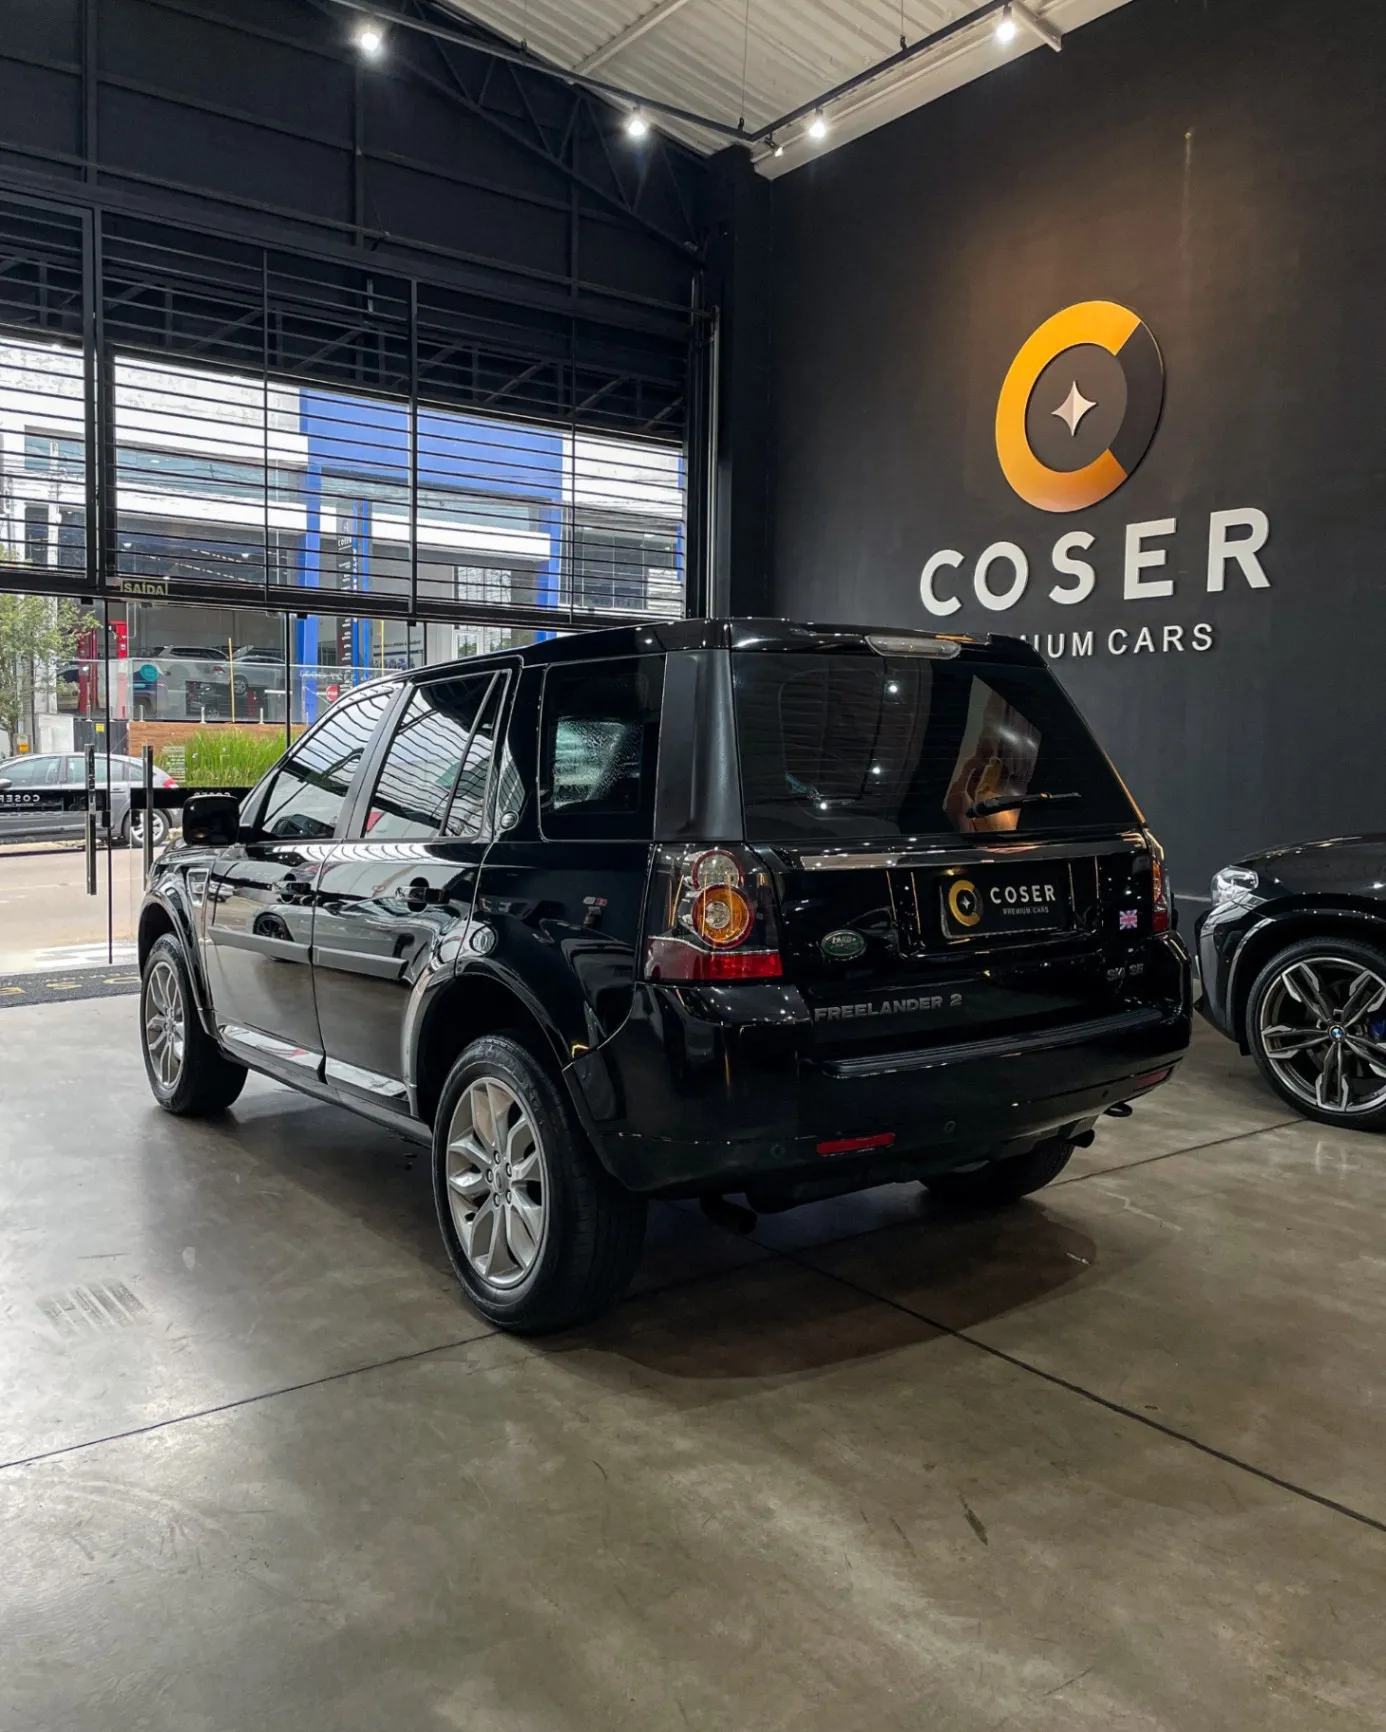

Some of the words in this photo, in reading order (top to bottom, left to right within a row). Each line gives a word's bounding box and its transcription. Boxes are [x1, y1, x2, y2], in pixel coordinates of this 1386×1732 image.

[920, 507, 1271, 616] COSER
[123, 582, 165, 596] SAÍDA
[1107, 623, 1213, 655] CARS
[990, 884, 1056, 904] COSER
[814, 995, 943, 1022] FREELANDER
[949, 993, 963, 1007] 2
